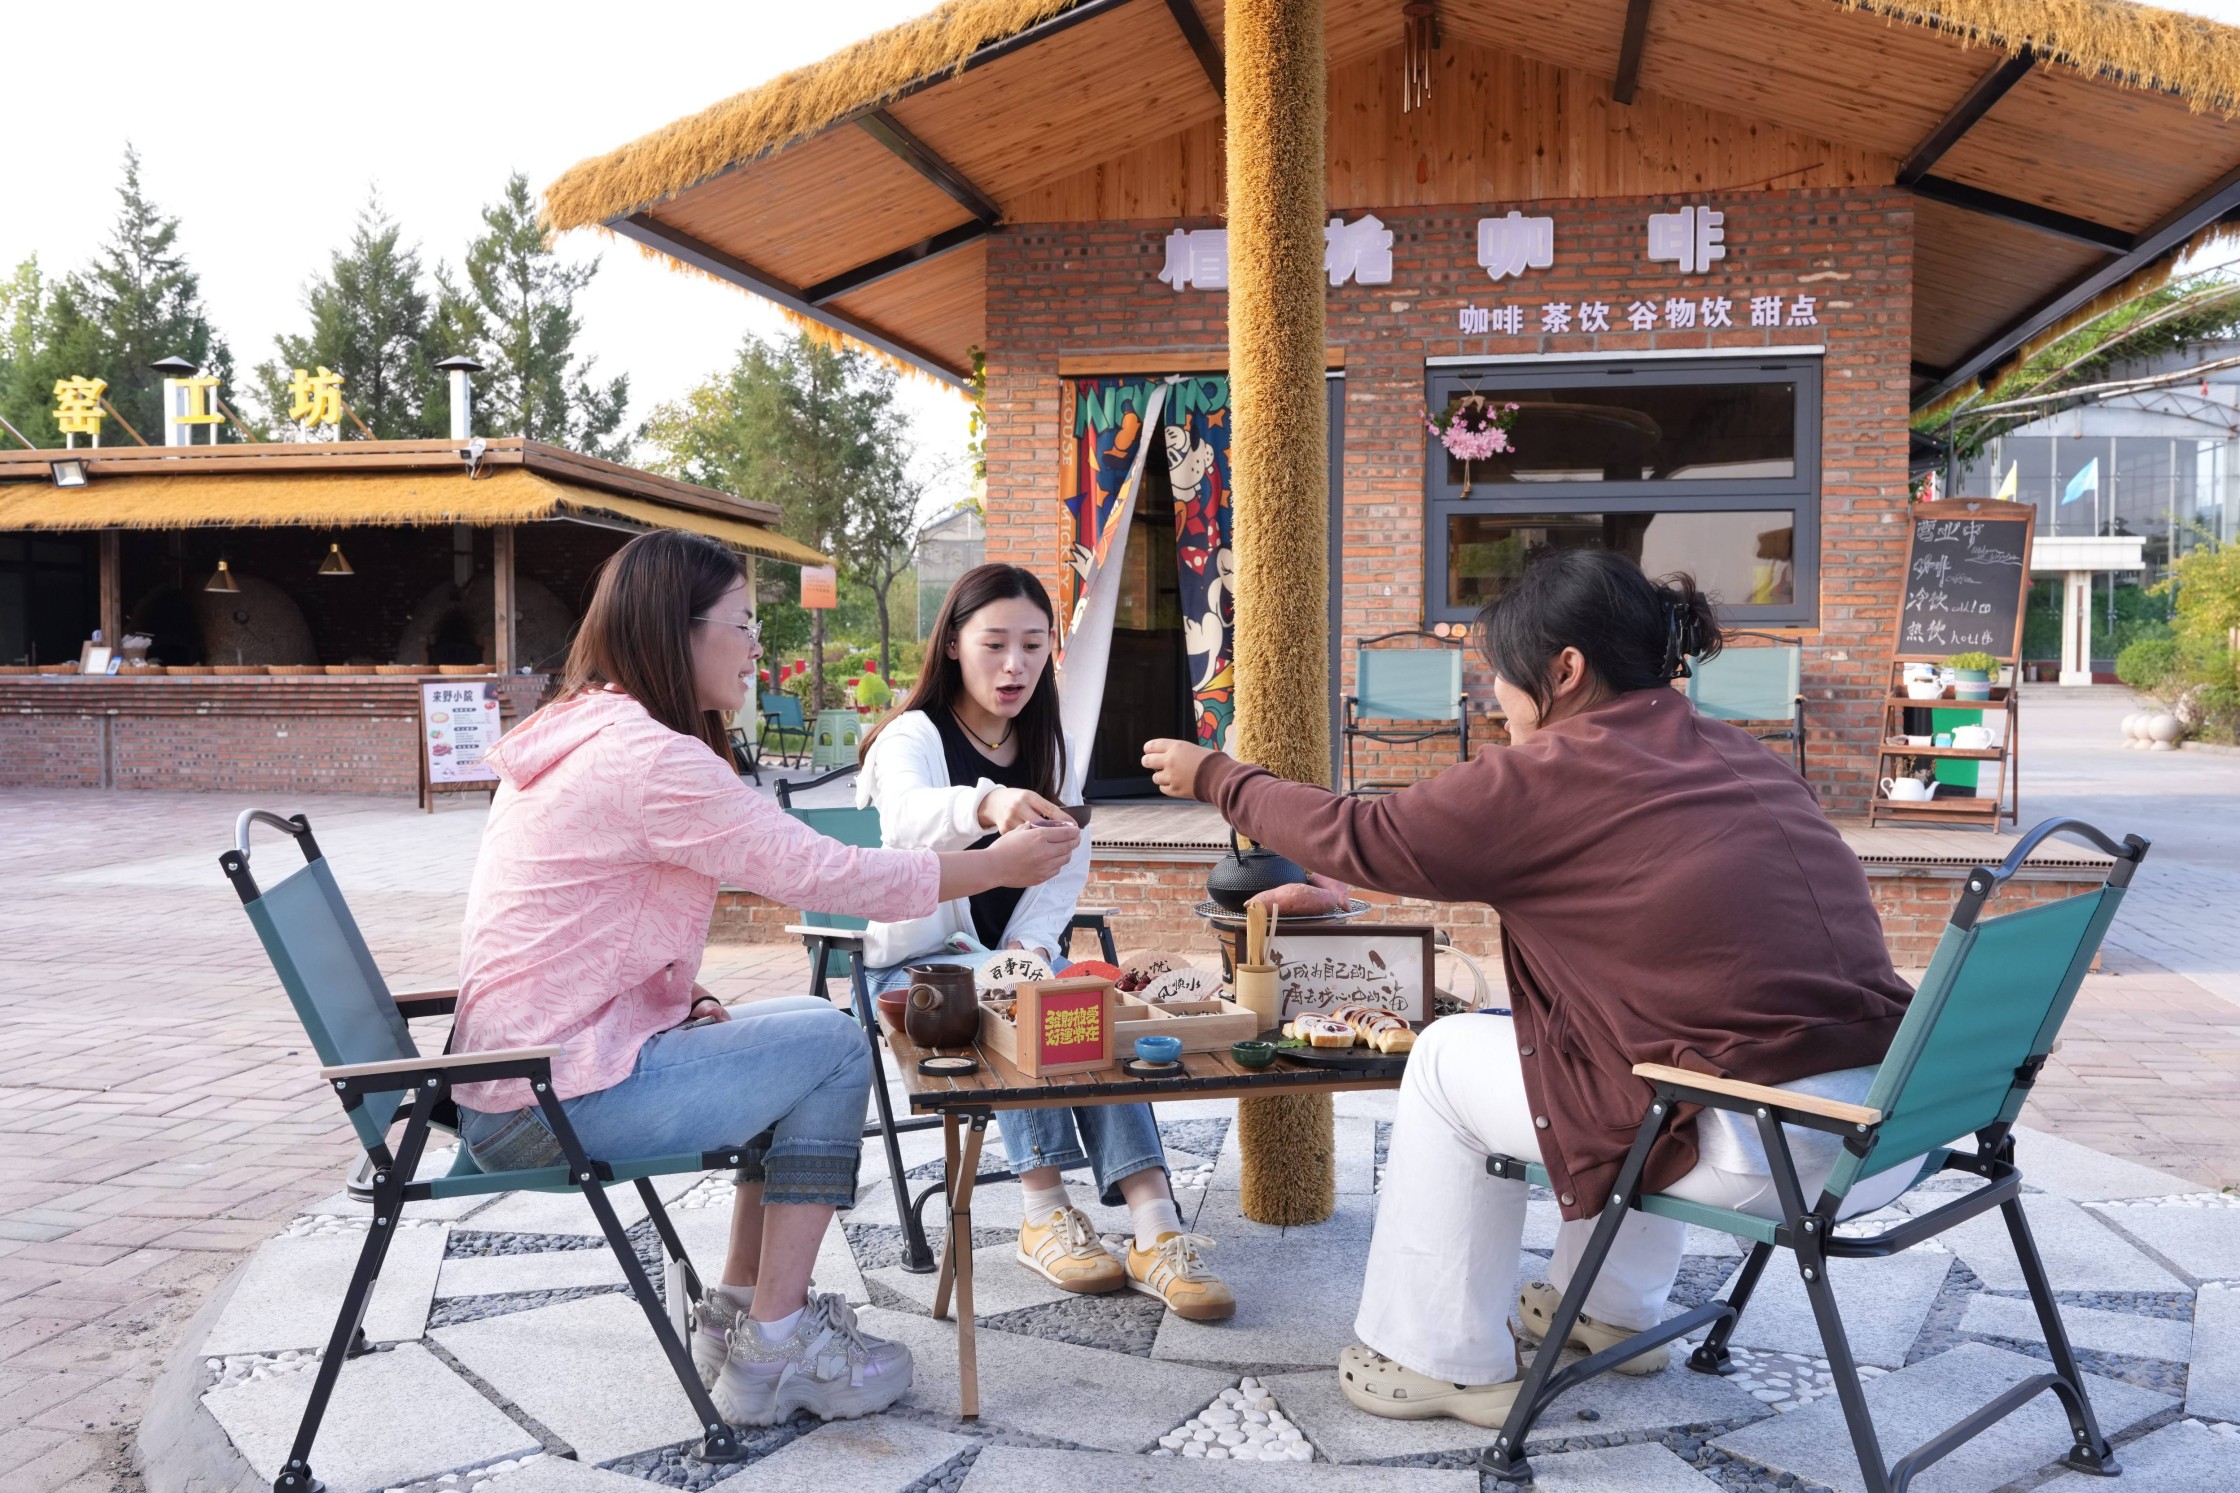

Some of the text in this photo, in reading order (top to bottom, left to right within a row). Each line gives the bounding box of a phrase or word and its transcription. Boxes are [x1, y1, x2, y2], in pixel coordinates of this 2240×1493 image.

[1459, 295, 1818, 335] 咖啡 茶饮 谷物饮 甜点
[53, 365, 345, 434] 窑工坊
[1905, 586, 1949, 612] 冷饮
[1906, 619, 1946, 646] 热饮
[432, 690, 474, 703] 来野小院
[989, 957, 1044, 982] 百事可乐
